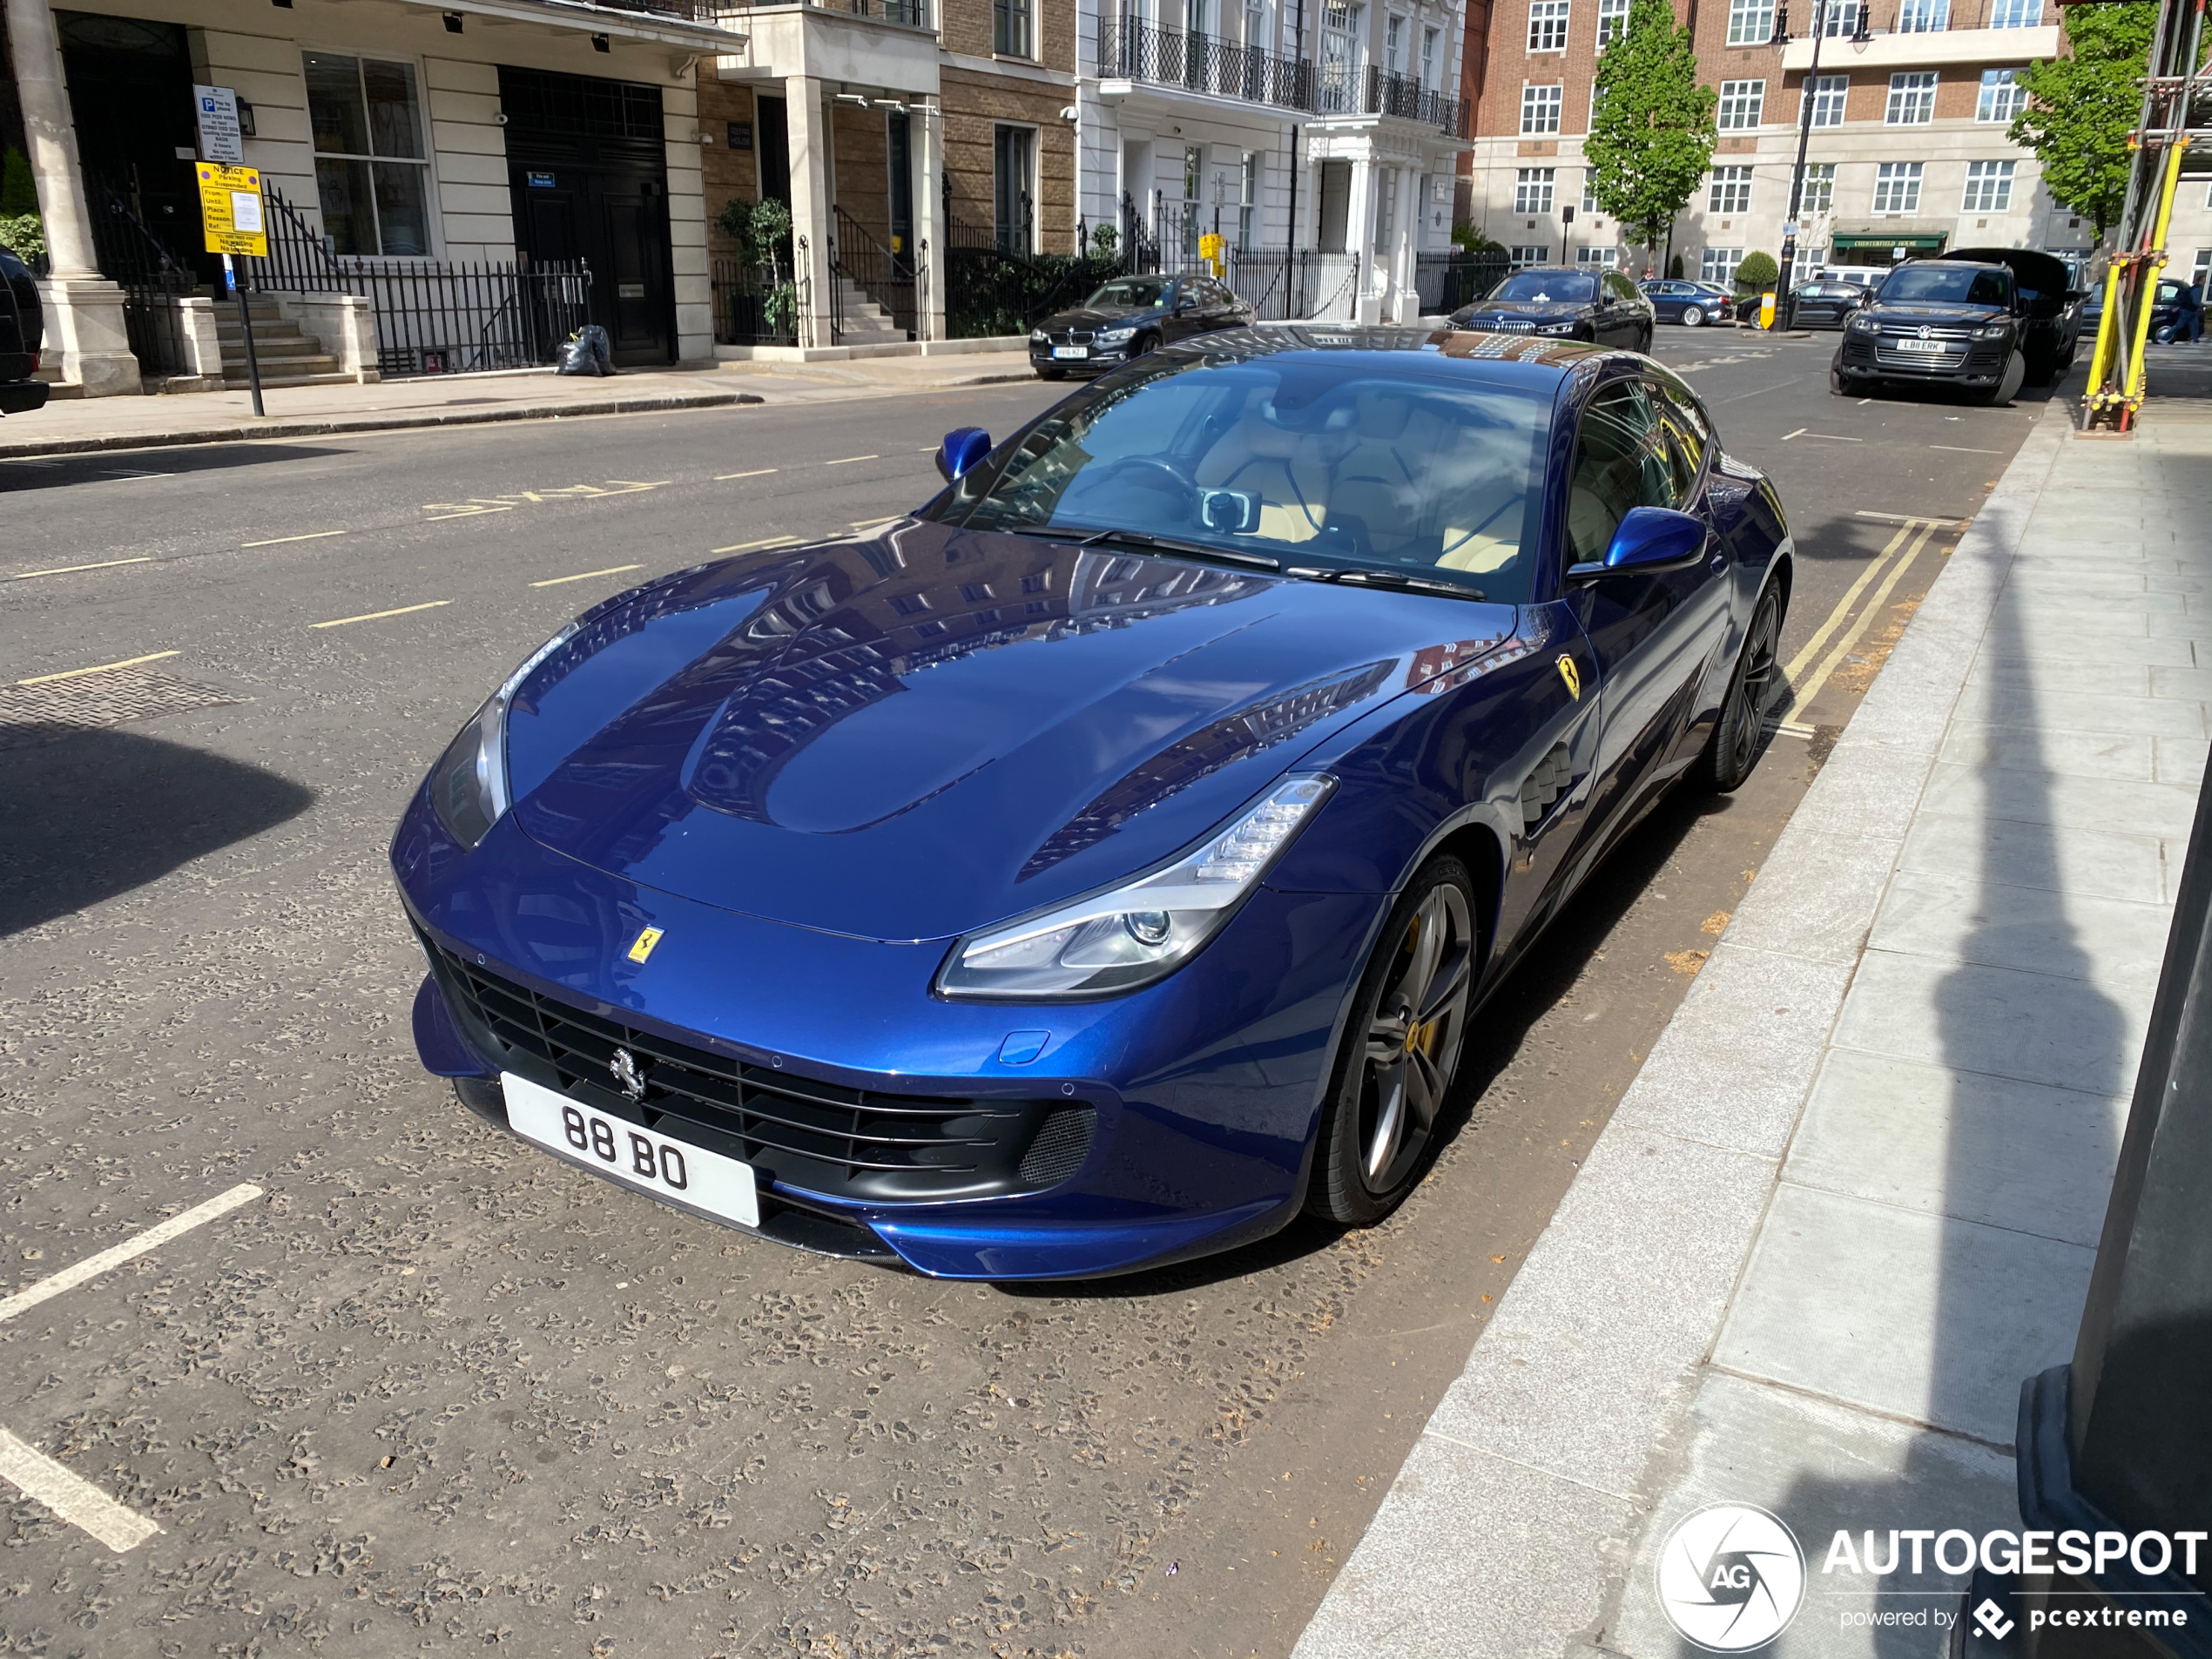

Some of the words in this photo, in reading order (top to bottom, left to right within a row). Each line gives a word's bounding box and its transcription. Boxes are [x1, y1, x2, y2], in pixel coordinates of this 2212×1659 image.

[213, 165, 244, 174] NOTICE
[562, 1105, 617, 1163] 88
[627, 1130, 688, 1190] BO
